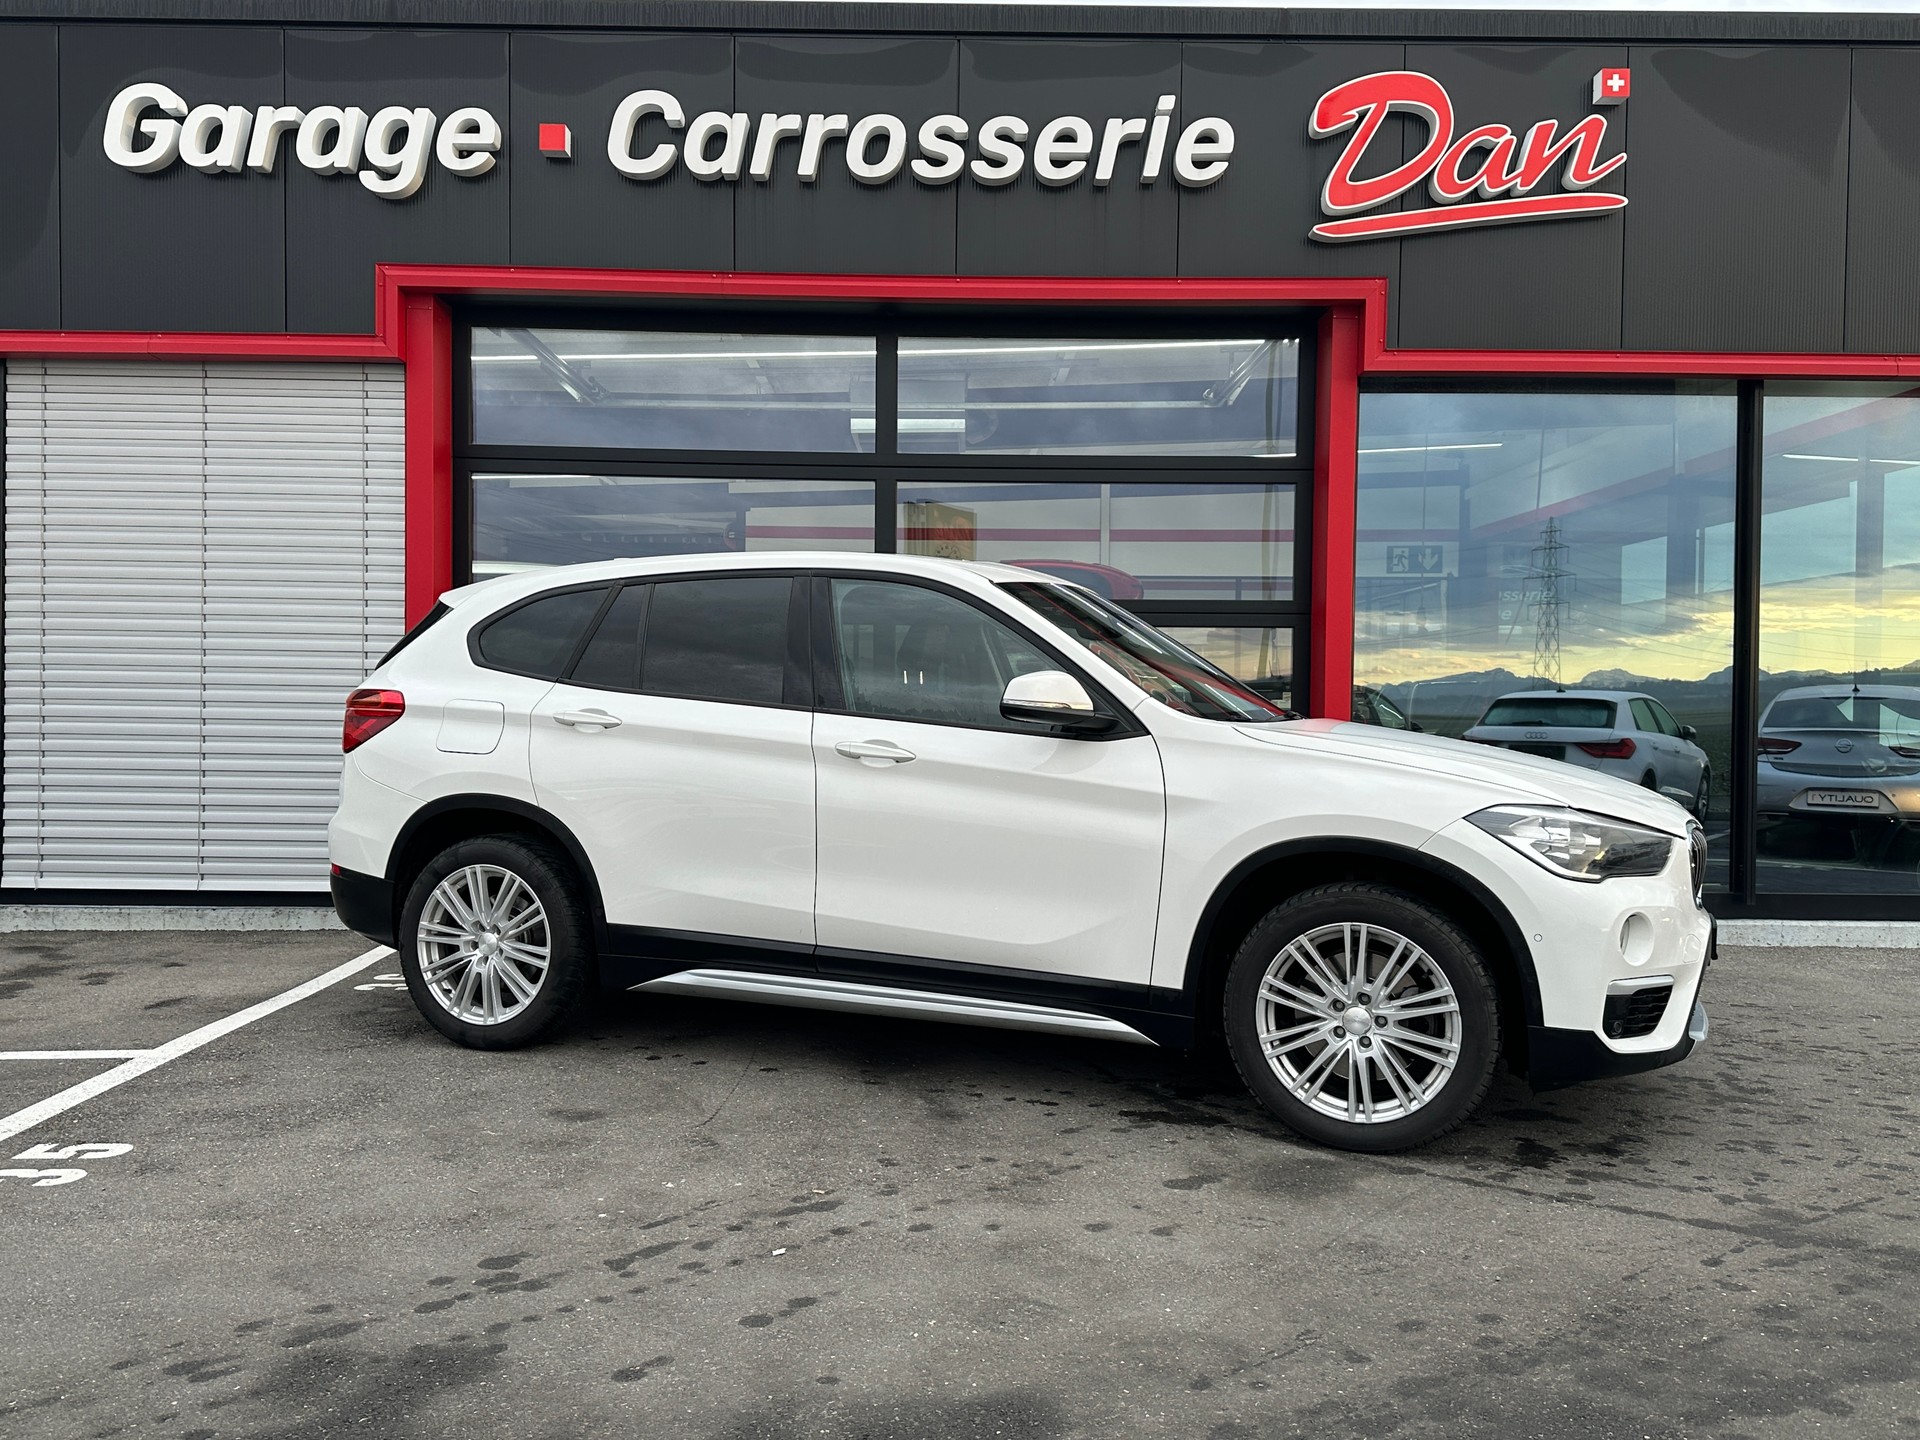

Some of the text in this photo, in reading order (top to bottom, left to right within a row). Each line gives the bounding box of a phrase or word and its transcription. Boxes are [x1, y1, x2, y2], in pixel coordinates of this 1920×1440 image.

[103, 70, 1628, 216] Garage Carrosserie Dan
[1499, 588, 1552, 601] sserie
[0, 1143, 134, 1187] 35
